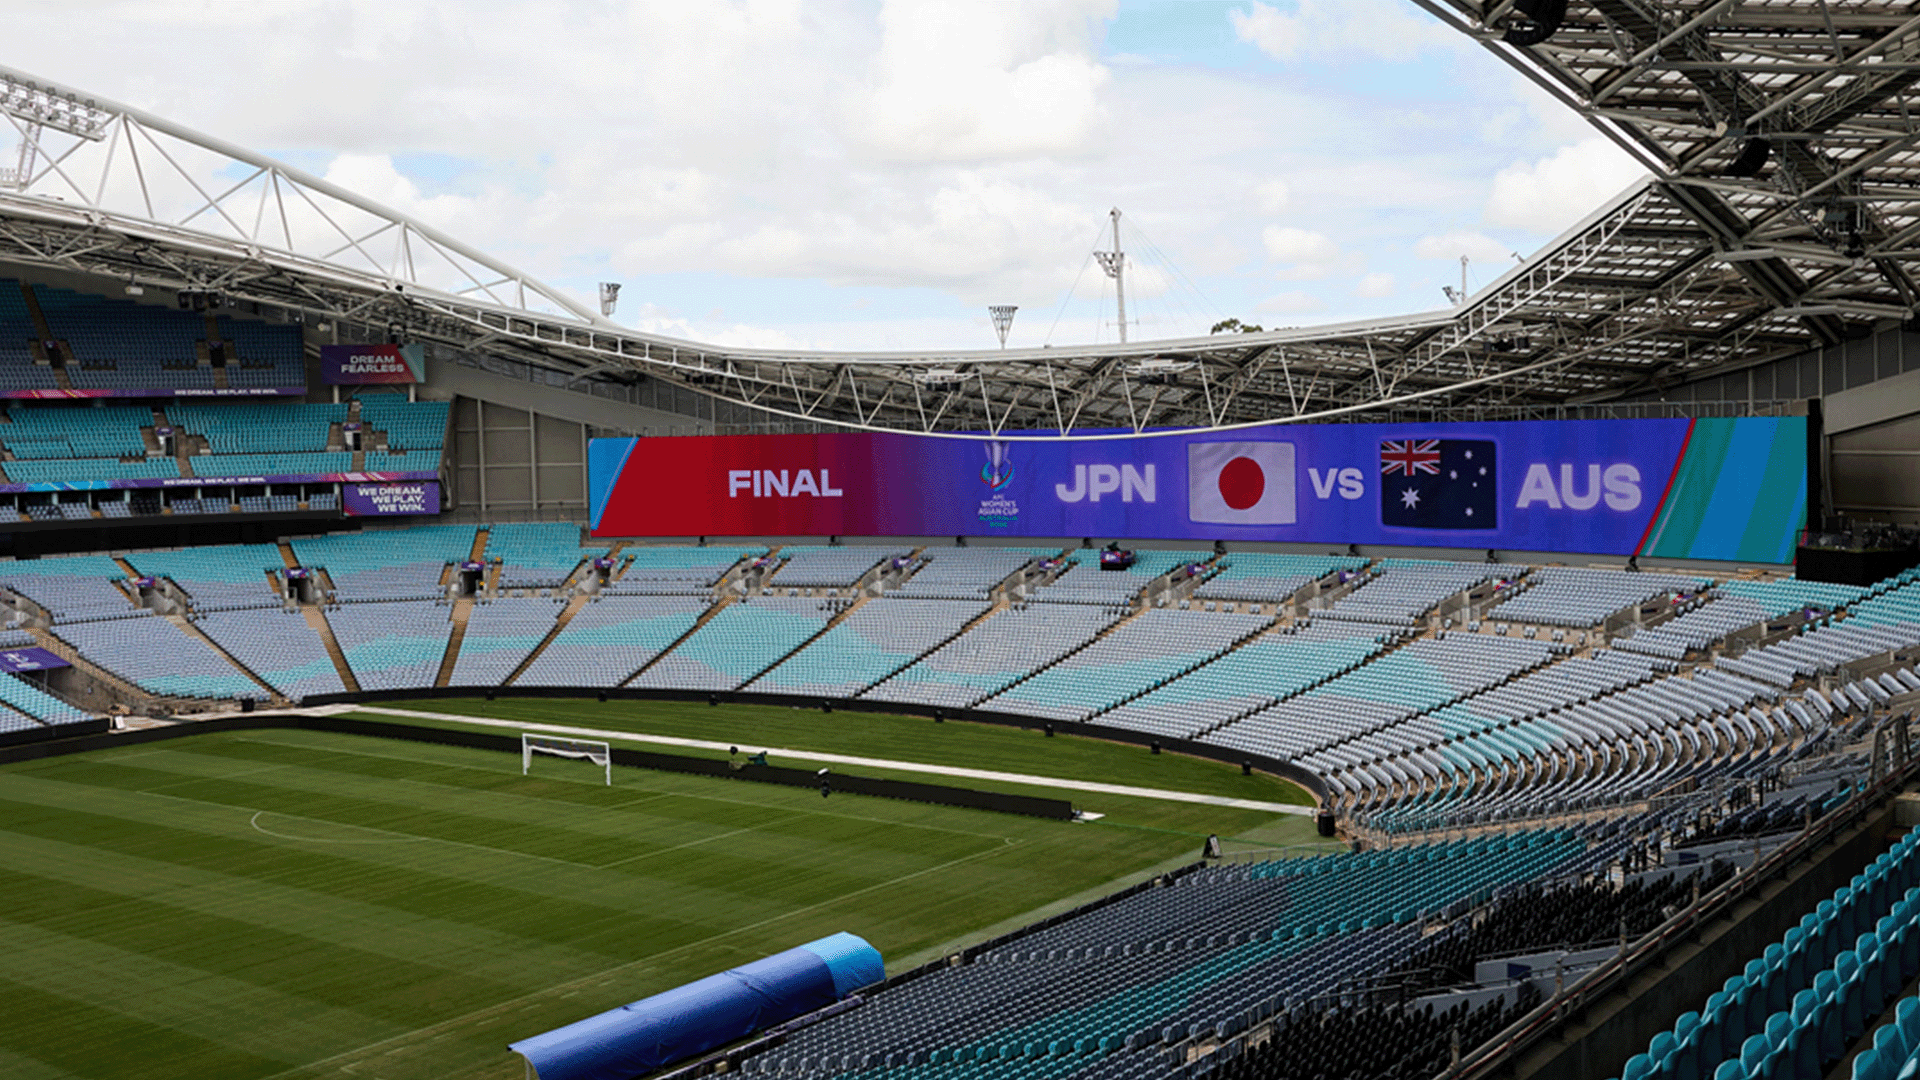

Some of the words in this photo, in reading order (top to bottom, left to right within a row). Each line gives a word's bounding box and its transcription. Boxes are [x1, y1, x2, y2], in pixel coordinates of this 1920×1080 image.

[350, 355, 396, 364] DREAM
[341, 364, 405, 373] FEARLESS
[728, 468, 843, 497] FINAL
[358, 487, 378, 496] WE
[379, 486, 425, 495] DREAM.
[1055, 464, 1156, 502] JPN
[1308, 467, 1364, 499] VS
[1515, 463, 1642, 512] AUS
[371, 495, 391, 504] WE
[392, 495, 426, 504] PLAY.
[378, 503, 398, 512] WE
[398, 503, 426, 512] WIN.
